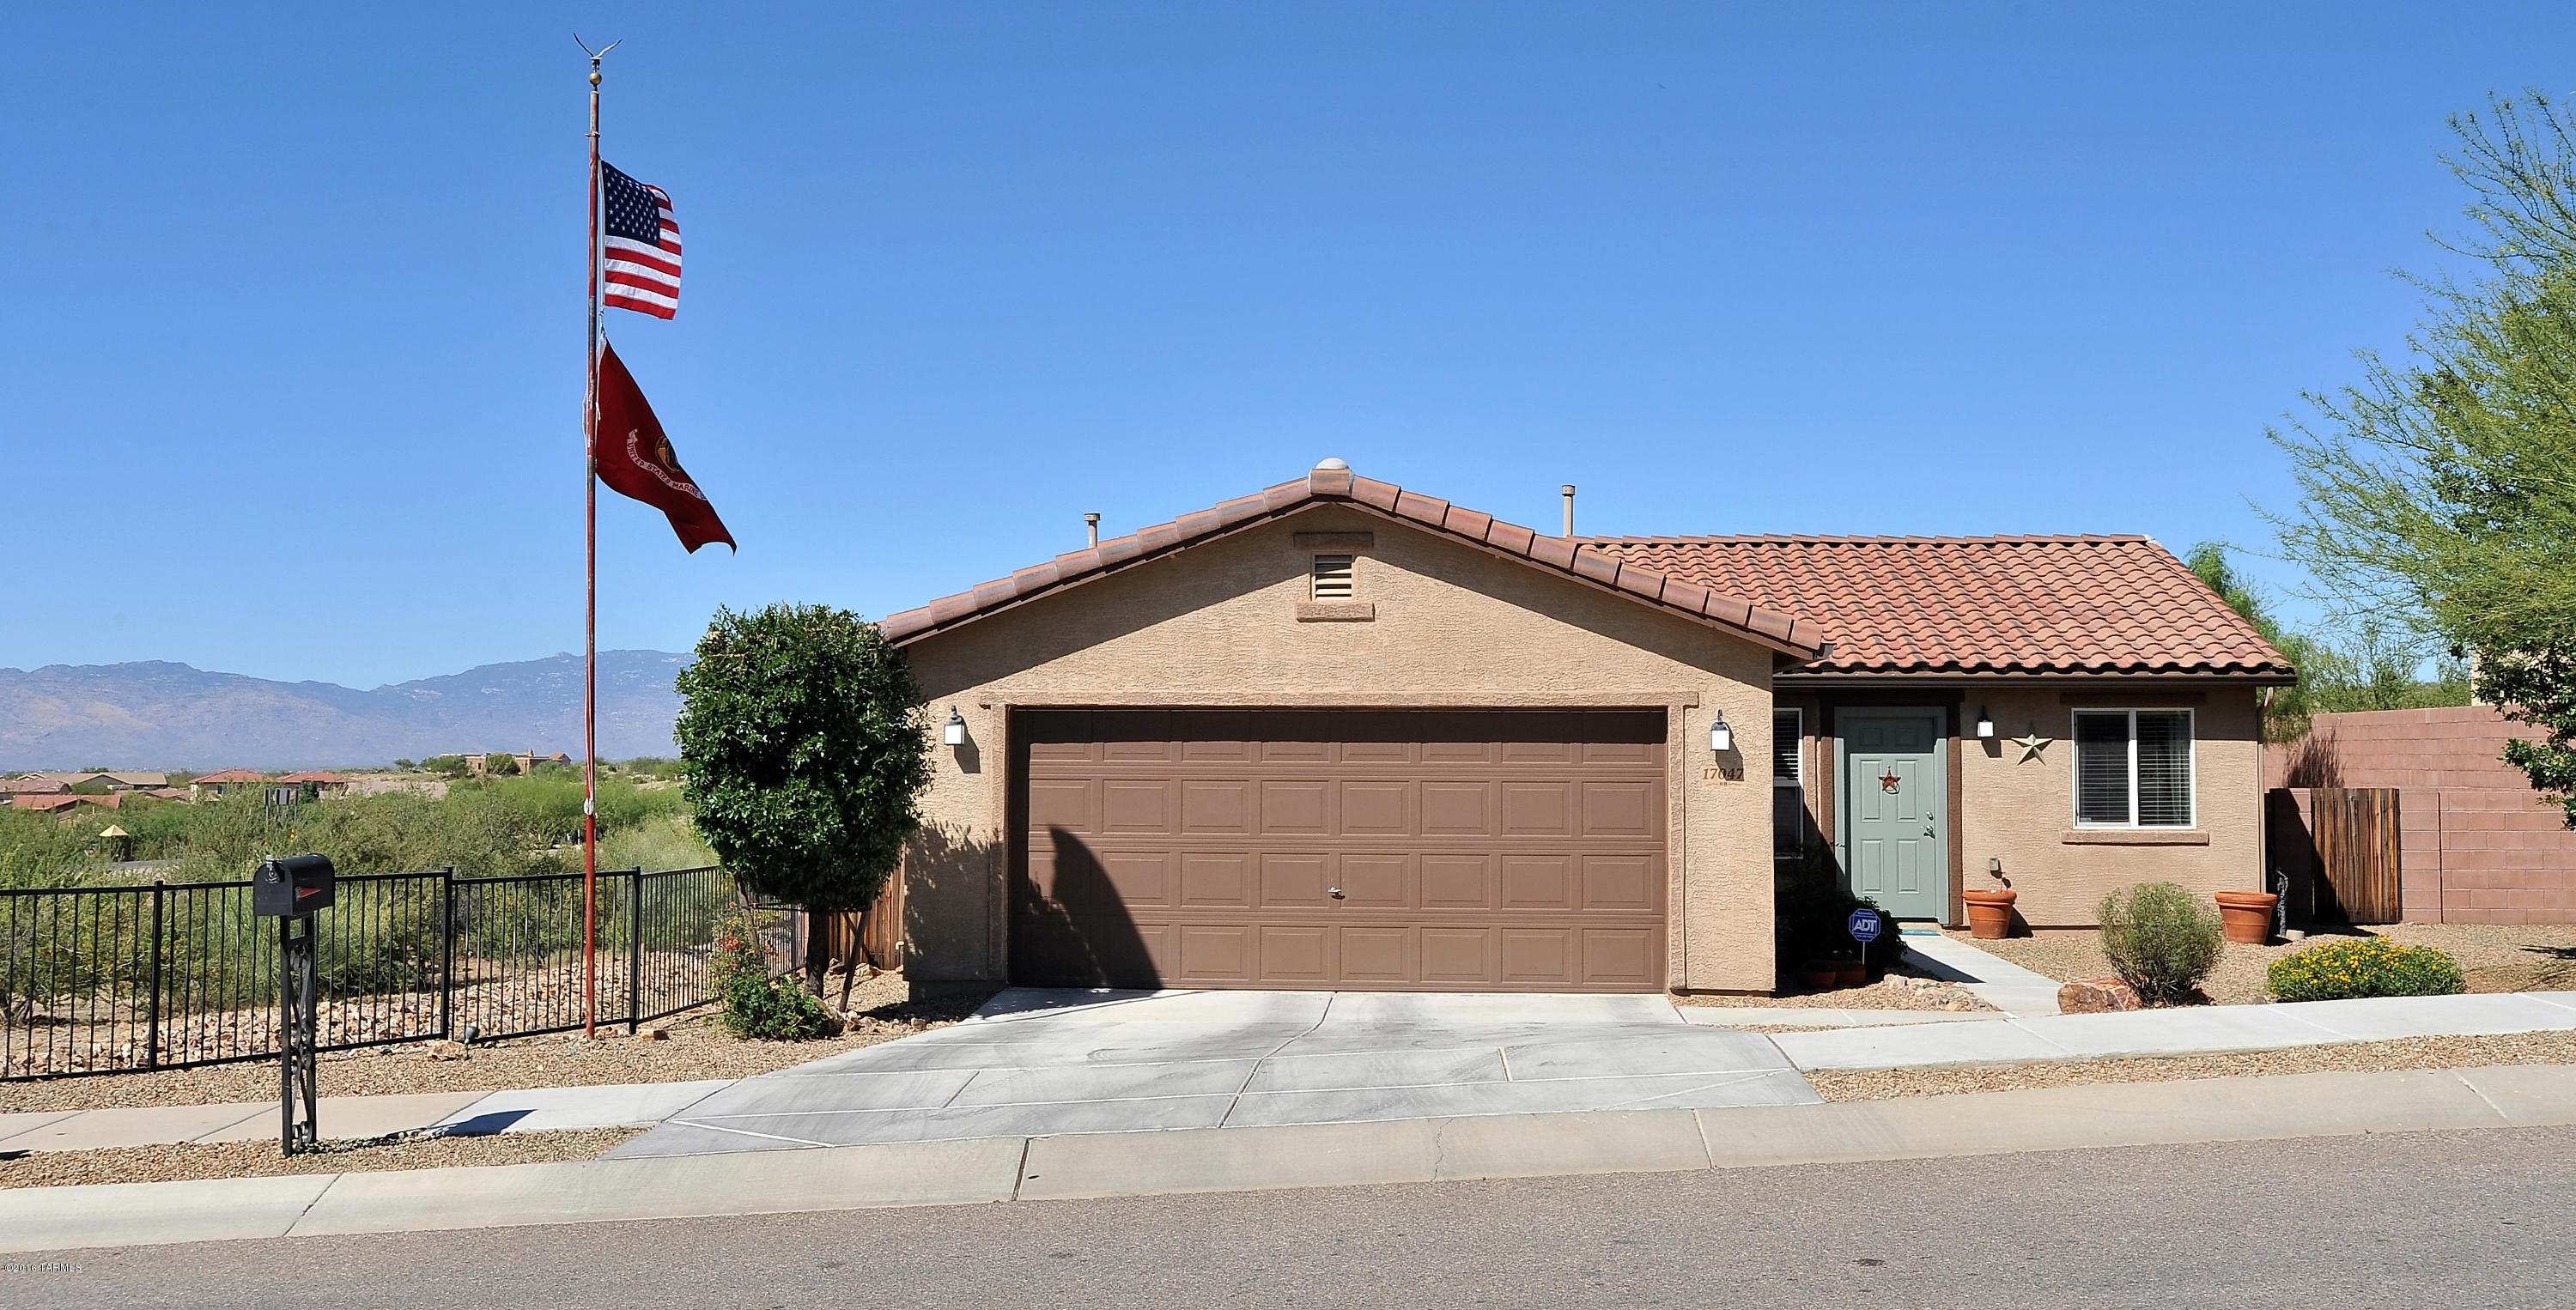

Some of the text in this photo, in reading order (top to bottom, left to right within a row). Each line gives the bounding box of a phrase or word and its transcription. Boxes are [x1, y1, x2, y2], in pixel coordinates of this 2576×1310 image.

[628, 442, 699, 496] UNITED STATES MARINE
[1703, 768, 1744, 779] 17047
[1853, 919, 1876, 931] ADT
